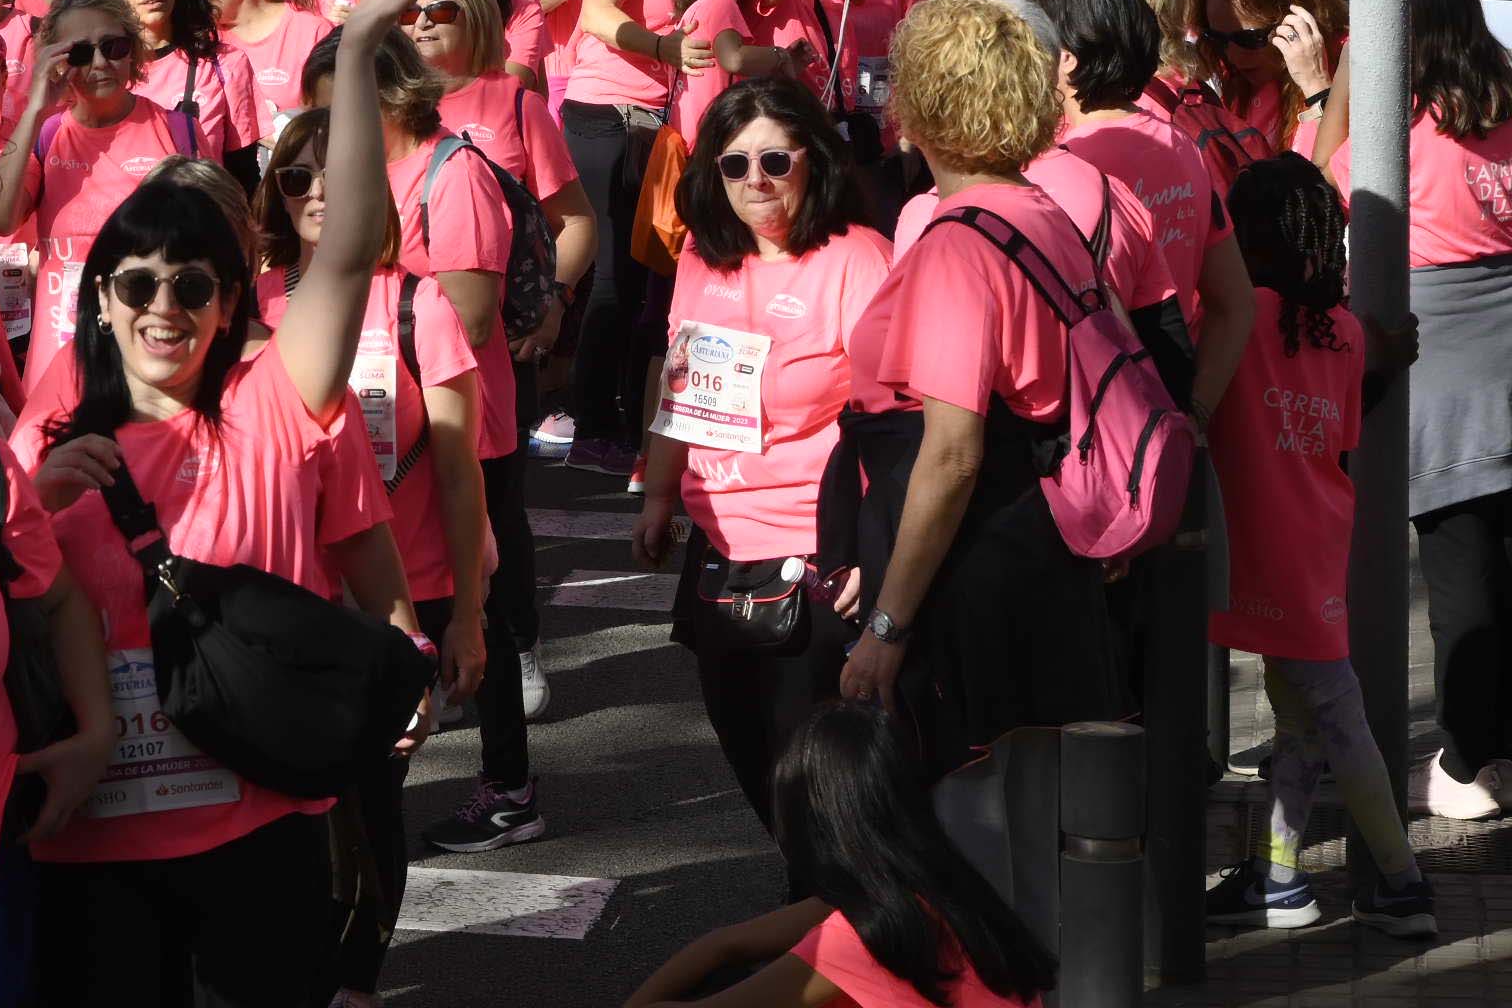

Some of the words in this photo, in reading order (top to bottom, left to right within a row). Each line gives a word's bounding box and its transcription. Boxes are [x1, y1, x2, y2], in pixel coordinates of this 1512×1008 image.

[693, 343, 730, 361] ASTURIANA
[691, 370, 723, 392] 016
[710, 410, 731, 423] MUJER
[714, 429, 751, 444] Santander
[119, 741, 165, 759] 12107
[170, 780, 224, 795] Santander
